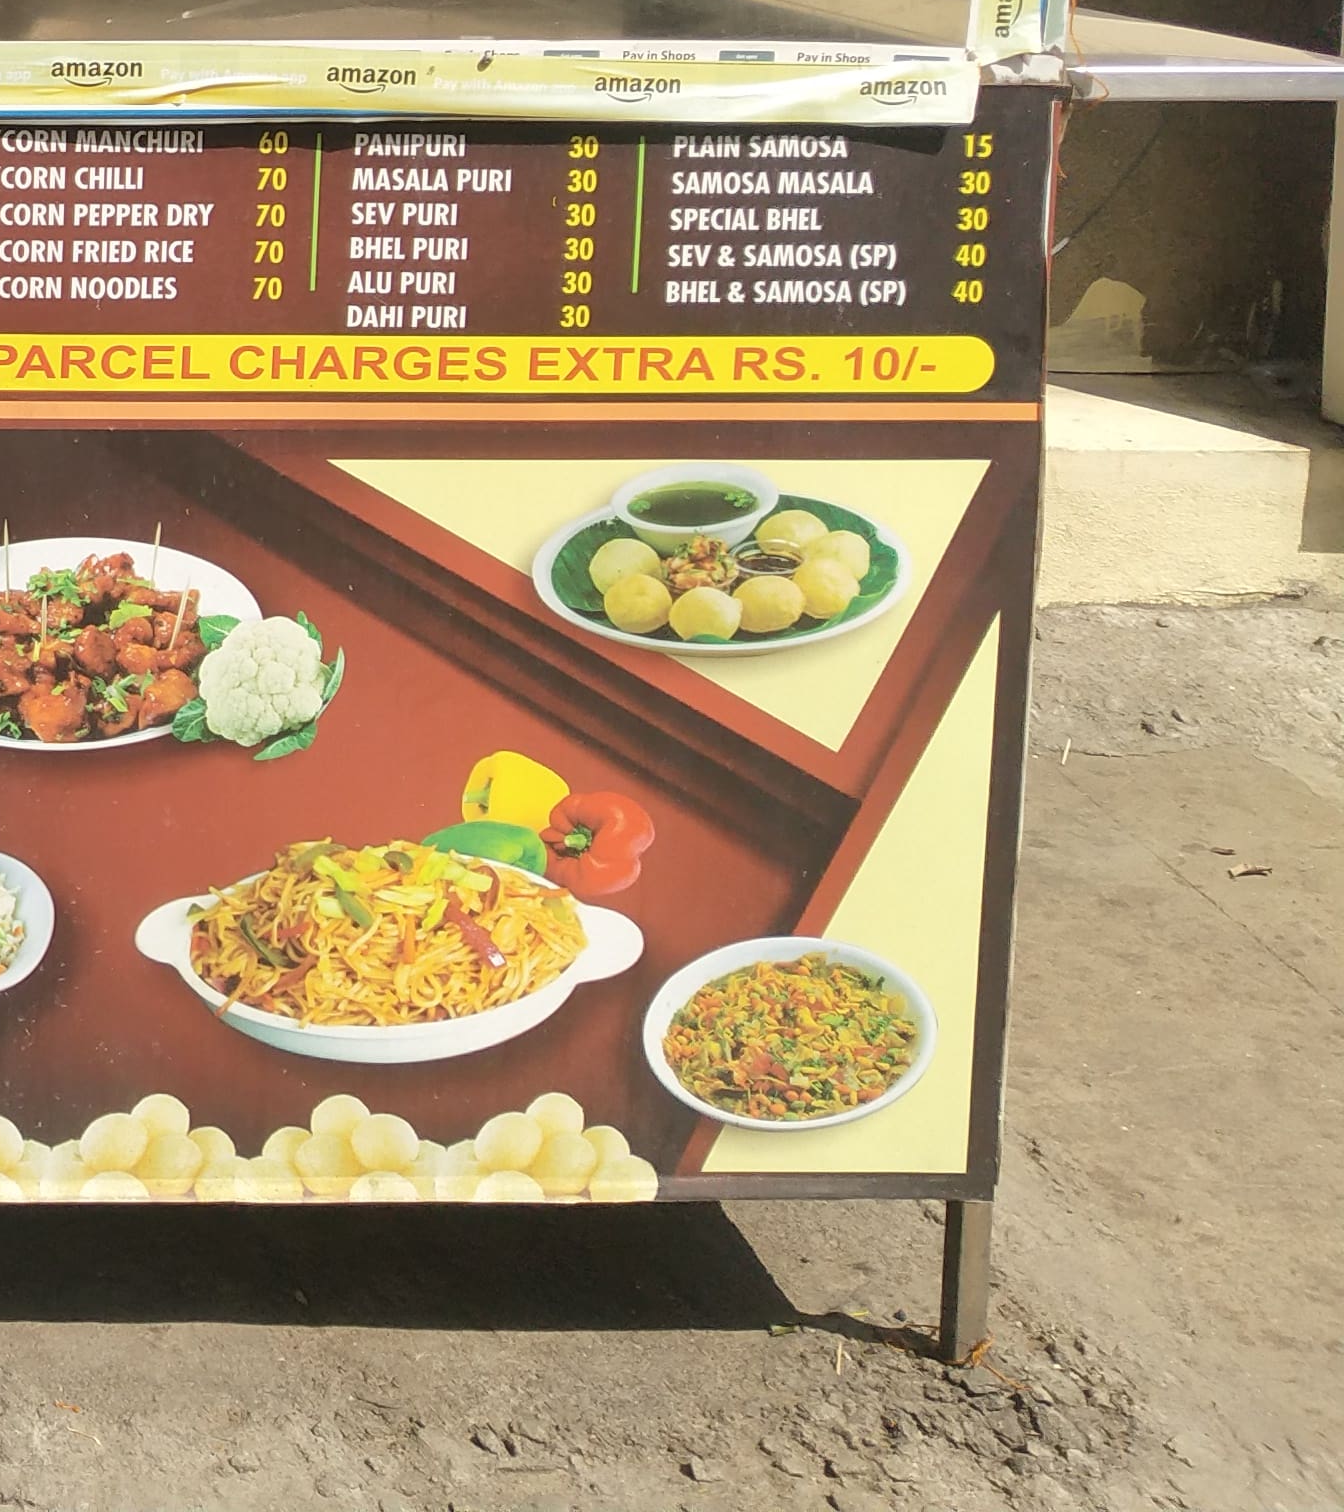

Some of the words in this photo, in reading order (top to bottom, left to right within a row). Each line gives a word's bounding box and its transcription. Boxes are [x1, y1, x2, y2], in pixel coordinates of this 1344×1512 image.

[51, 59, 143, 78] amazon
[327, 65, 416, 85] amazon
[594, 76, 681, 94] amazon
[859, 78, 947, 96] amazon
[75, 131, 202, 153] MANCHURI
[259, 132, 287, 154] 60
[354, 134, 465, 157] PANIPURI
[569, 137, 598, 158] 30
[674, 136, 740, 157] PLAIN
[749, 136, 847, 157] SAMOSA
[964, 135, 992, 157] 15
[75, 167, 143, 189] CHILLI
[258, 168, 286, 190] 70
[352, 168, 448, 191] MASALA
[457, 169, 511, 191] PURI
[568, 170, 596, 192] 30
[673, 172, 770, 194] SAMOSA
[778, 172, 873, 194] MASALA
[959, 172, 990, 194] 30
[352, 203, 395, 224] SEV
[403, 203, 457, 225] PURI
[566, 204, 595, 226] 30
[671, 208, 759, 230] SPECIAL
[767, 208, 821, 230] BHEL
[958, 208, 987, 230] 30
[669, 245, 711, 267] SEV
[718, 246, 735, 266] &
[744, 245, 842, 266] SAMOSA
[851, 245, 896, 269] (SP)
[956, 244, 985, 266] 40
[71, 277, 177, 299] NOODLES
[254, 278, 282, 299] 70
[666, 281, 720, 303] BHEL
[728, 282, 745, 302] &
[754, 281, 852, 302] SAMOSA
[860, 281, 906, 305] (SP)
[953, 281, 982, 302] 40
[347, 306, 403, 327] DAHI
[412, 306, 466, 328] PURI
[561, 306, 589, 327] 30
[230, 346, 506, 381] CHARGES
[529, 348, 714, 380] EXTRA
[734, 347, 818, 380] RS.
[845, 347, 936, 380] 10/-
